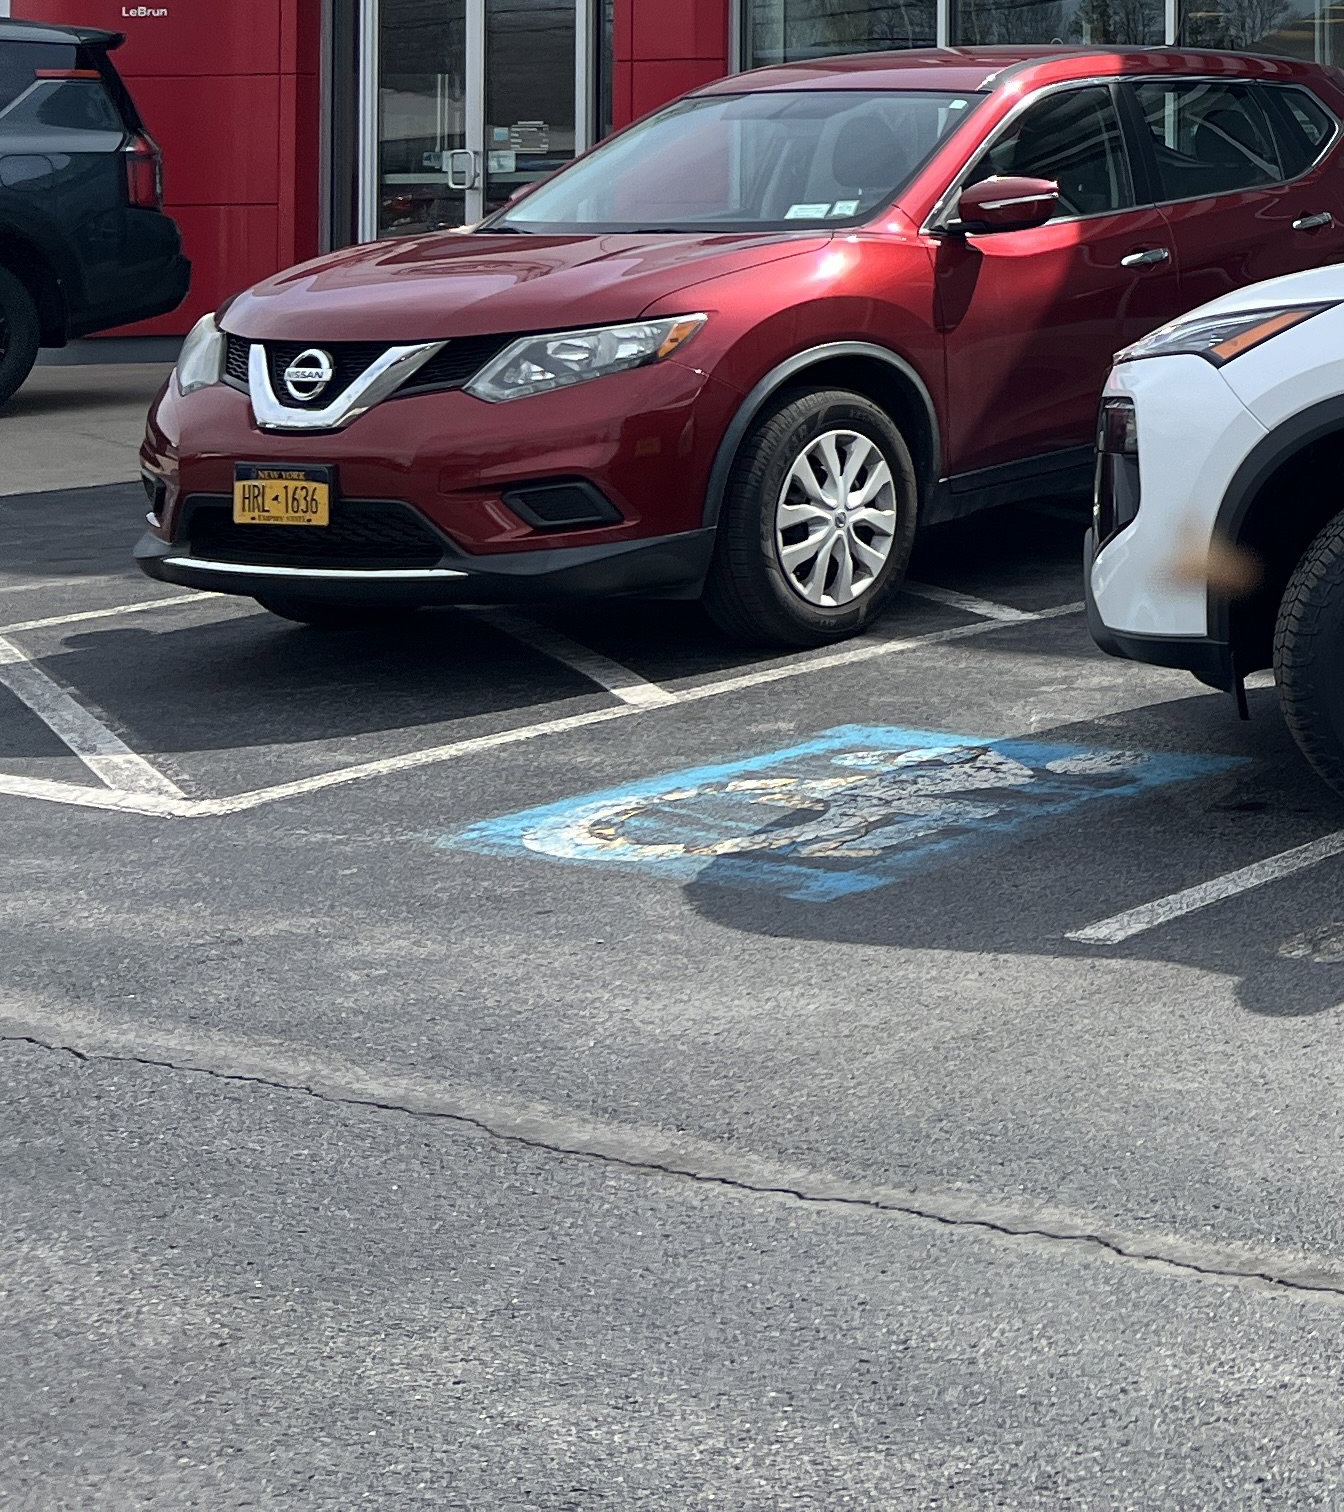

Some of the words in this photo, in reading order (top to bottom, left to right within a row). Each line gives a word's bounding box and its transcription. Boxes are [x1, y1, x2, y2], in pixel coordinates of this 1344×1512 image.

[121, 6, 168, 17] LeBrun
[286, 370, 324, 379] NISSAN
[258, 470, 280, 480] NEW
[281, 471, 306, 480] YORK
